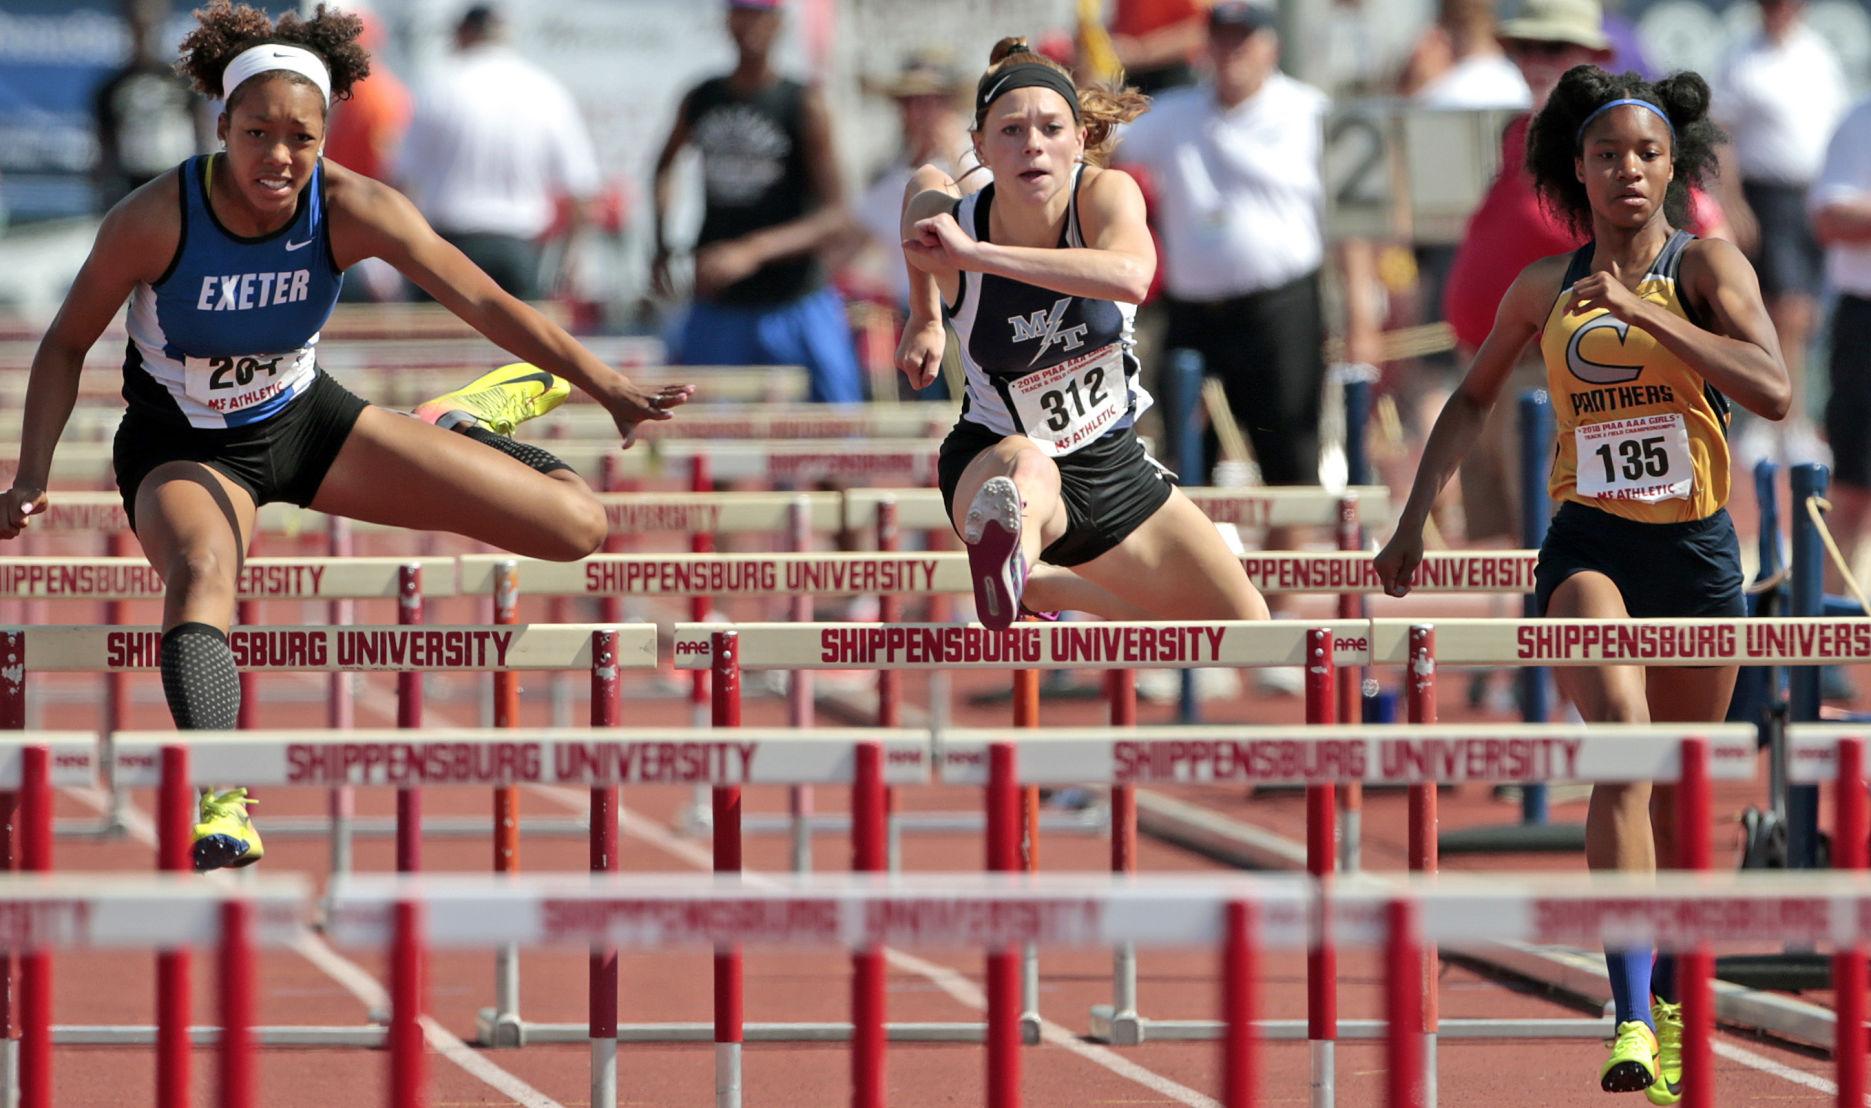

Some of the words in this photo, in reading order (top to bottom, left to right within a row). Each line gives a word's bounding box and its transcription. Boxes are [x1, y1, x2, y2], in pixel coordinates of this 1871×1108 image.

[197, 269, 310, 311] EXETER
[229, 381, 284, 409] ATHLETIC
[1040, 366, 1109, 432] 312
[1570, 384, 1675, 417] PANTHERS
[1073, 404, 1117, 445] ATHLETIC
[1626, 418, 1646, 429] AAA
[1648, 414, 1676, 425] GIRLS
[1596, 436, 1669, 484] 135
[1616, 483, 1675, 500] ATHLETIC
[237, 565, 325, 594] ERSITY
[585, 560, 776, 592] SHIPPENSBURG
[786, 559, 938, 591] UNIVERSITY
[1411, 557, 1538, 587] NIVERSIT
[107, 631, 328, 667] SHISBURG
[337, 631, 513, 667] UNIVERSITY
[821, 627, 1041, 663] SHIPPENSBURG
[1051, 626, 1226, 662] UNIVERSITY
[1517, 624, 1736, 659] SHIPPENSBURG
[286, 743, 542, 783] SHIPPENSBURG
[554, 741, 760, 783] UNIVERSITY
[1112, 740, 1366, 781] SHIPPENSBURG
[1379, 737, 1584, 779] UNIVERSITY
